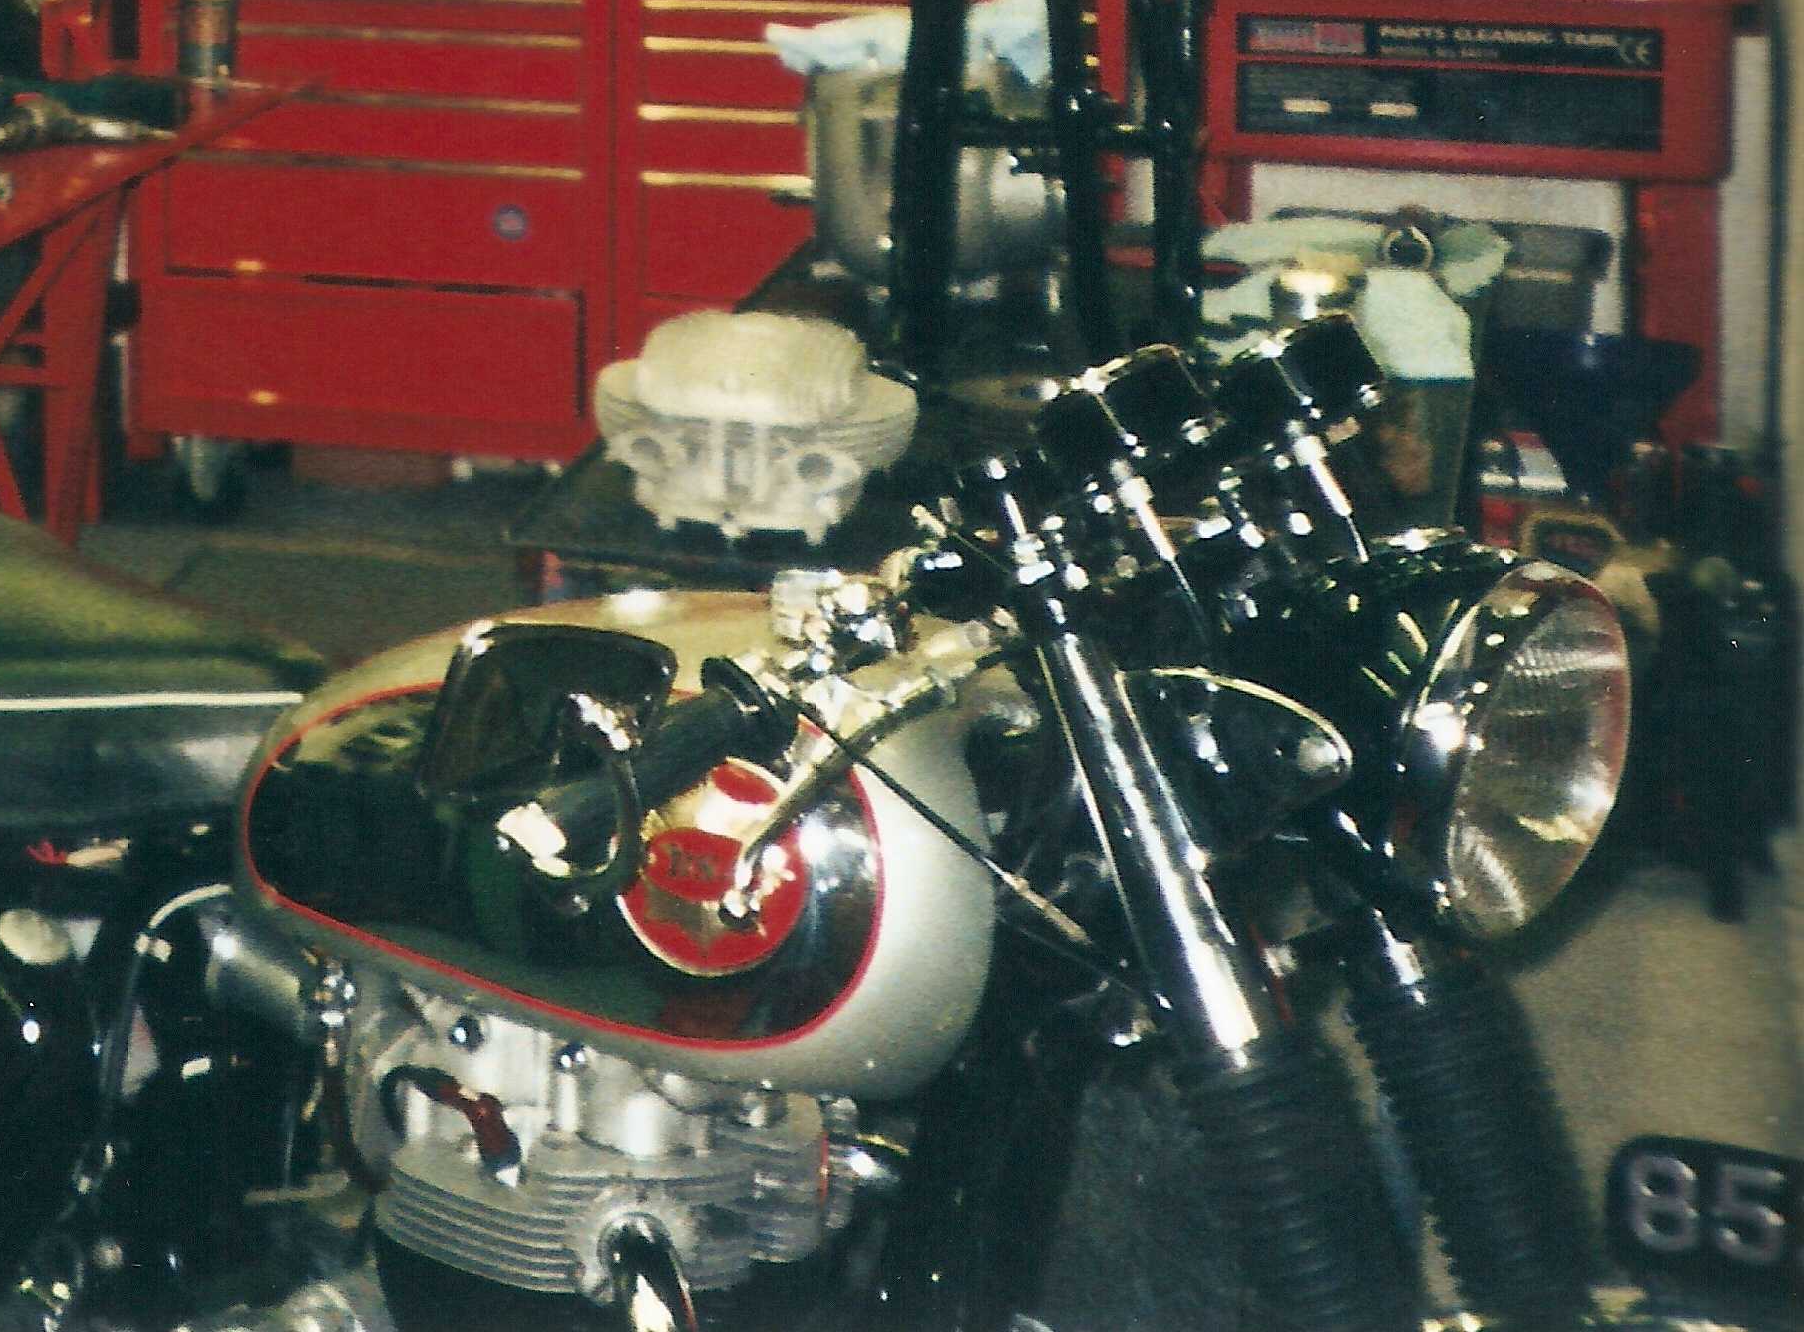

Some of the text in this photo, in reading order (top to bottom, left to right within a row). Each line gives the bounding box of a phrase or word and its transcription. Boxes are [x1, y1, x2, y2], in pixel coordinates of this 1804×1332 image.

[1379, 25, 1445, 41] PARTS
[1453, 27, 1554, 45] CLEANING
[1627, 1154, 1786, 1262] 85
